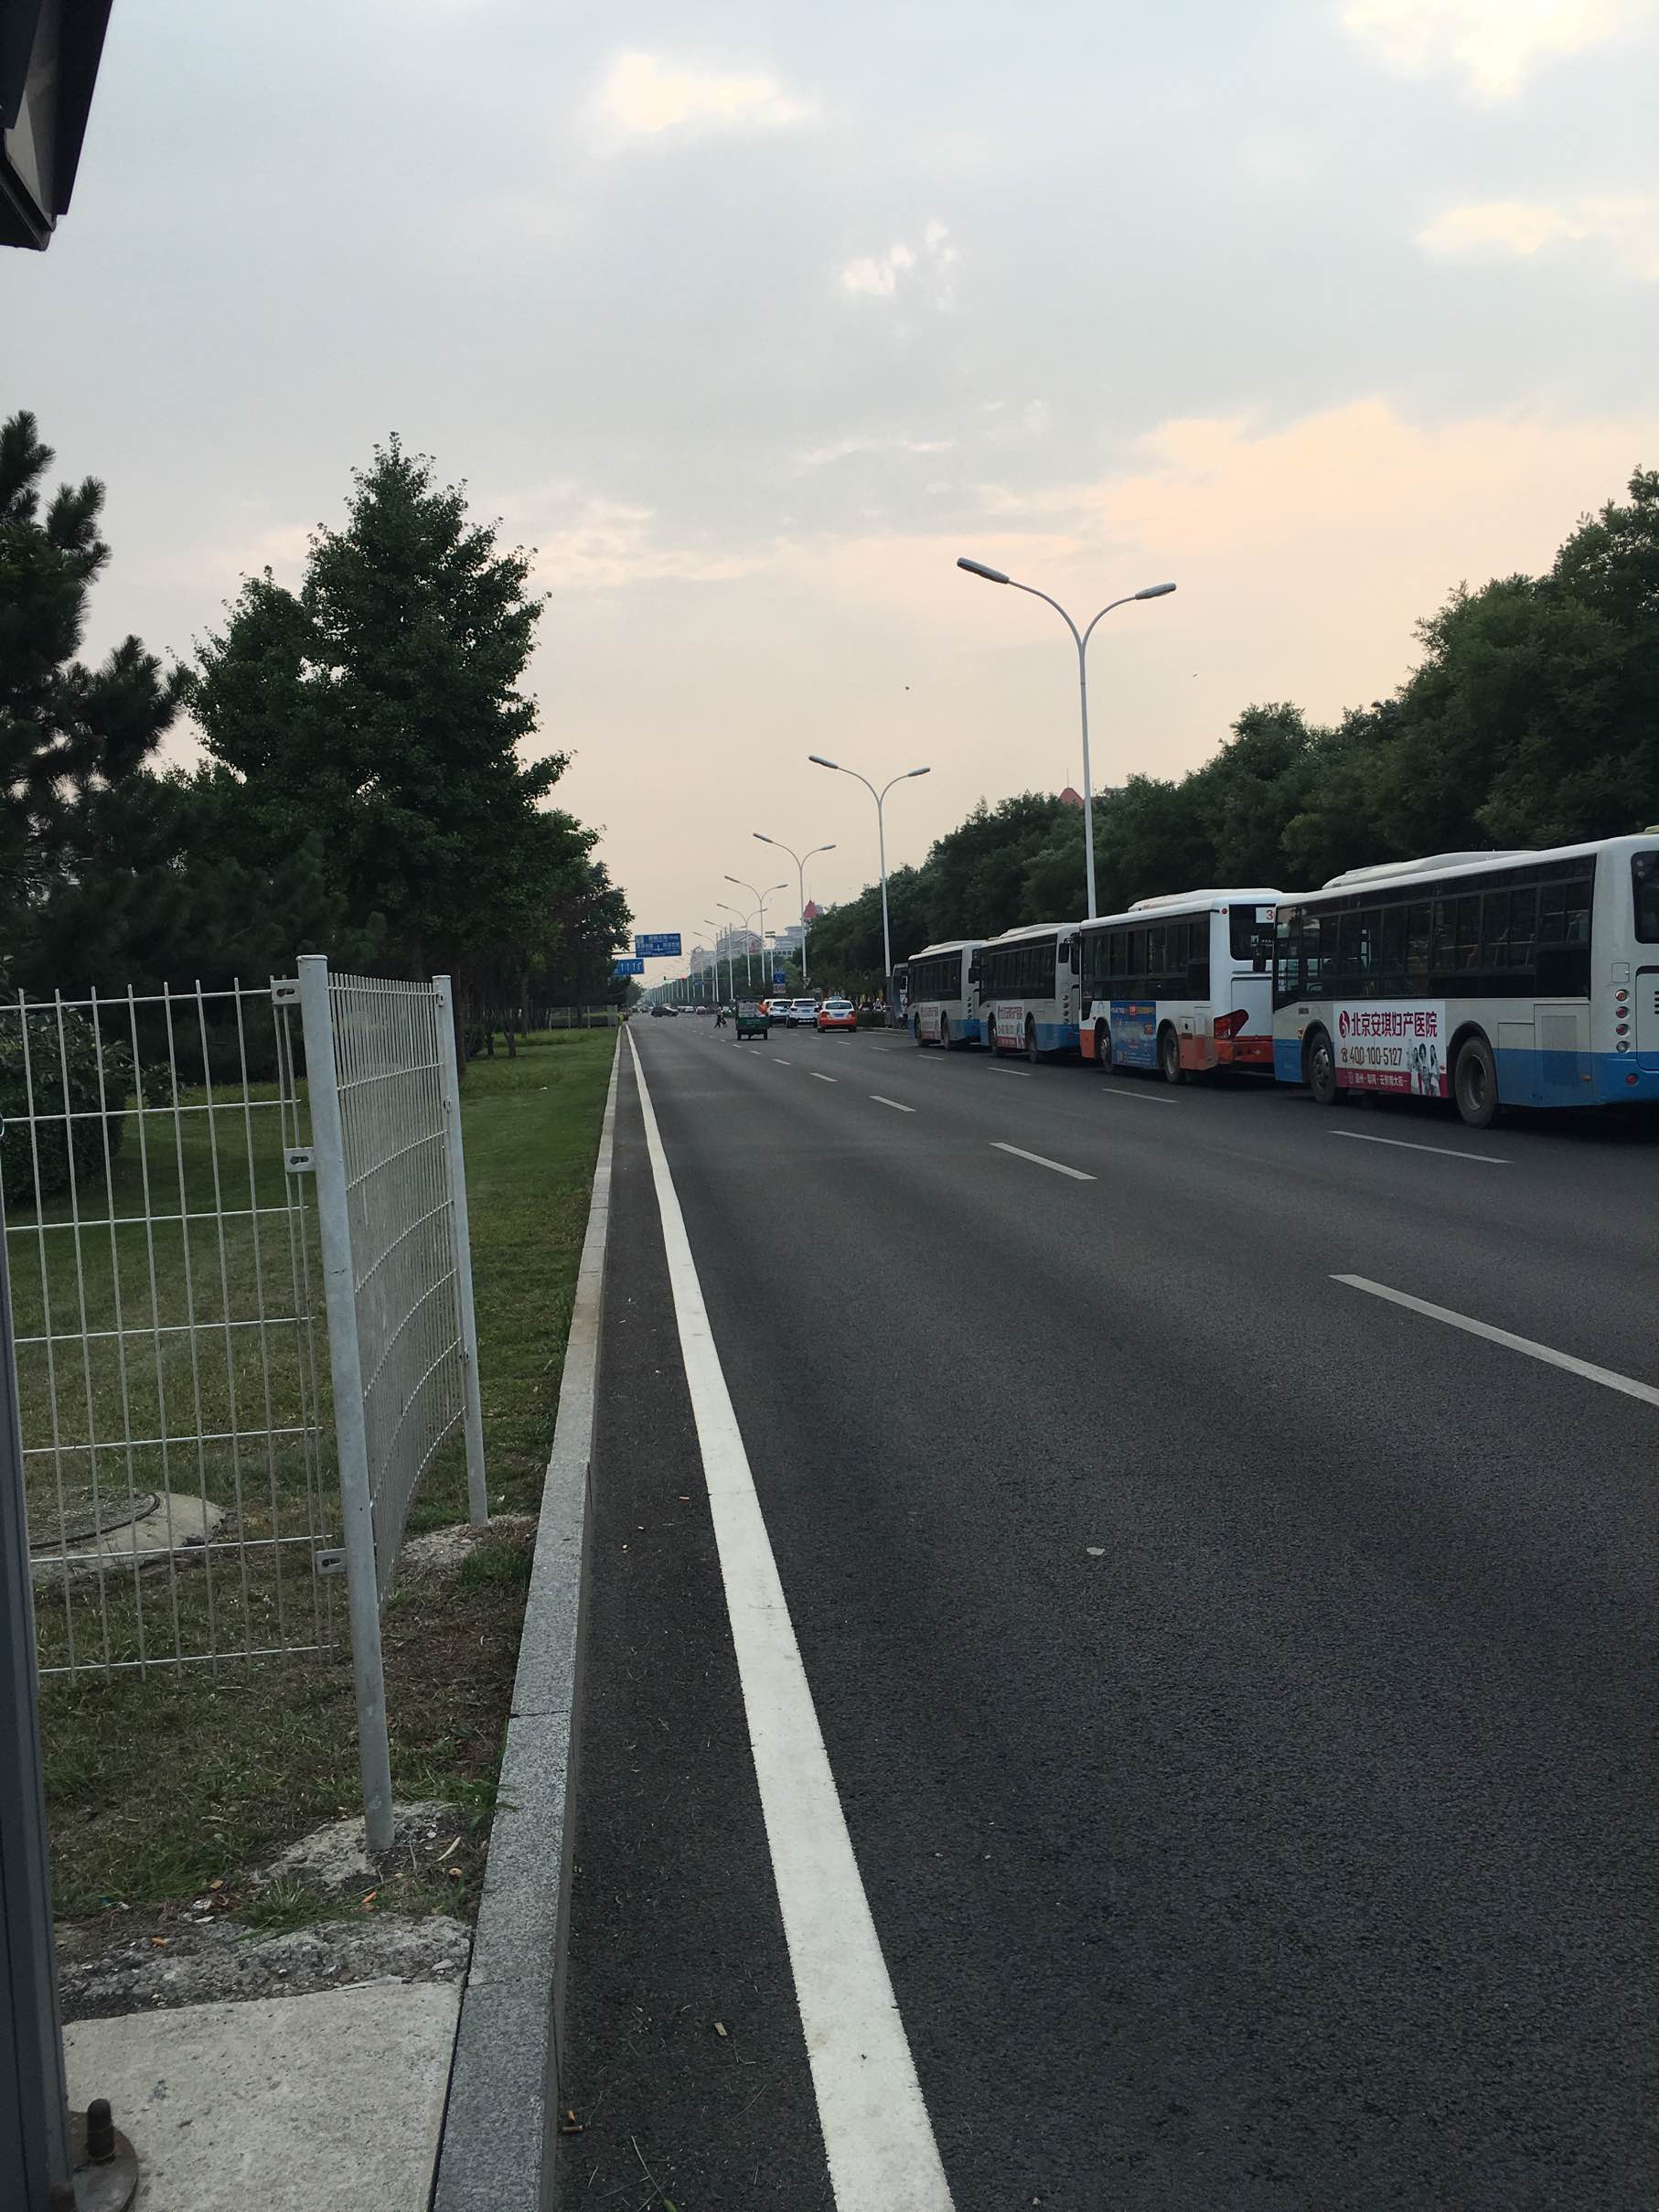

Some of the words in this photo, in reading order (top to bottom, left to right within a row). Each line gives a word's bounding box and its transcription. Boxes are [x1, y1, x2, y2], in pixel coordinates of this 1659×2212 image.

[1351, 1011, 1438, 1038] 北京安琪妇产医院
[1350, 1046, 1403, 1067] 400-100-5127
